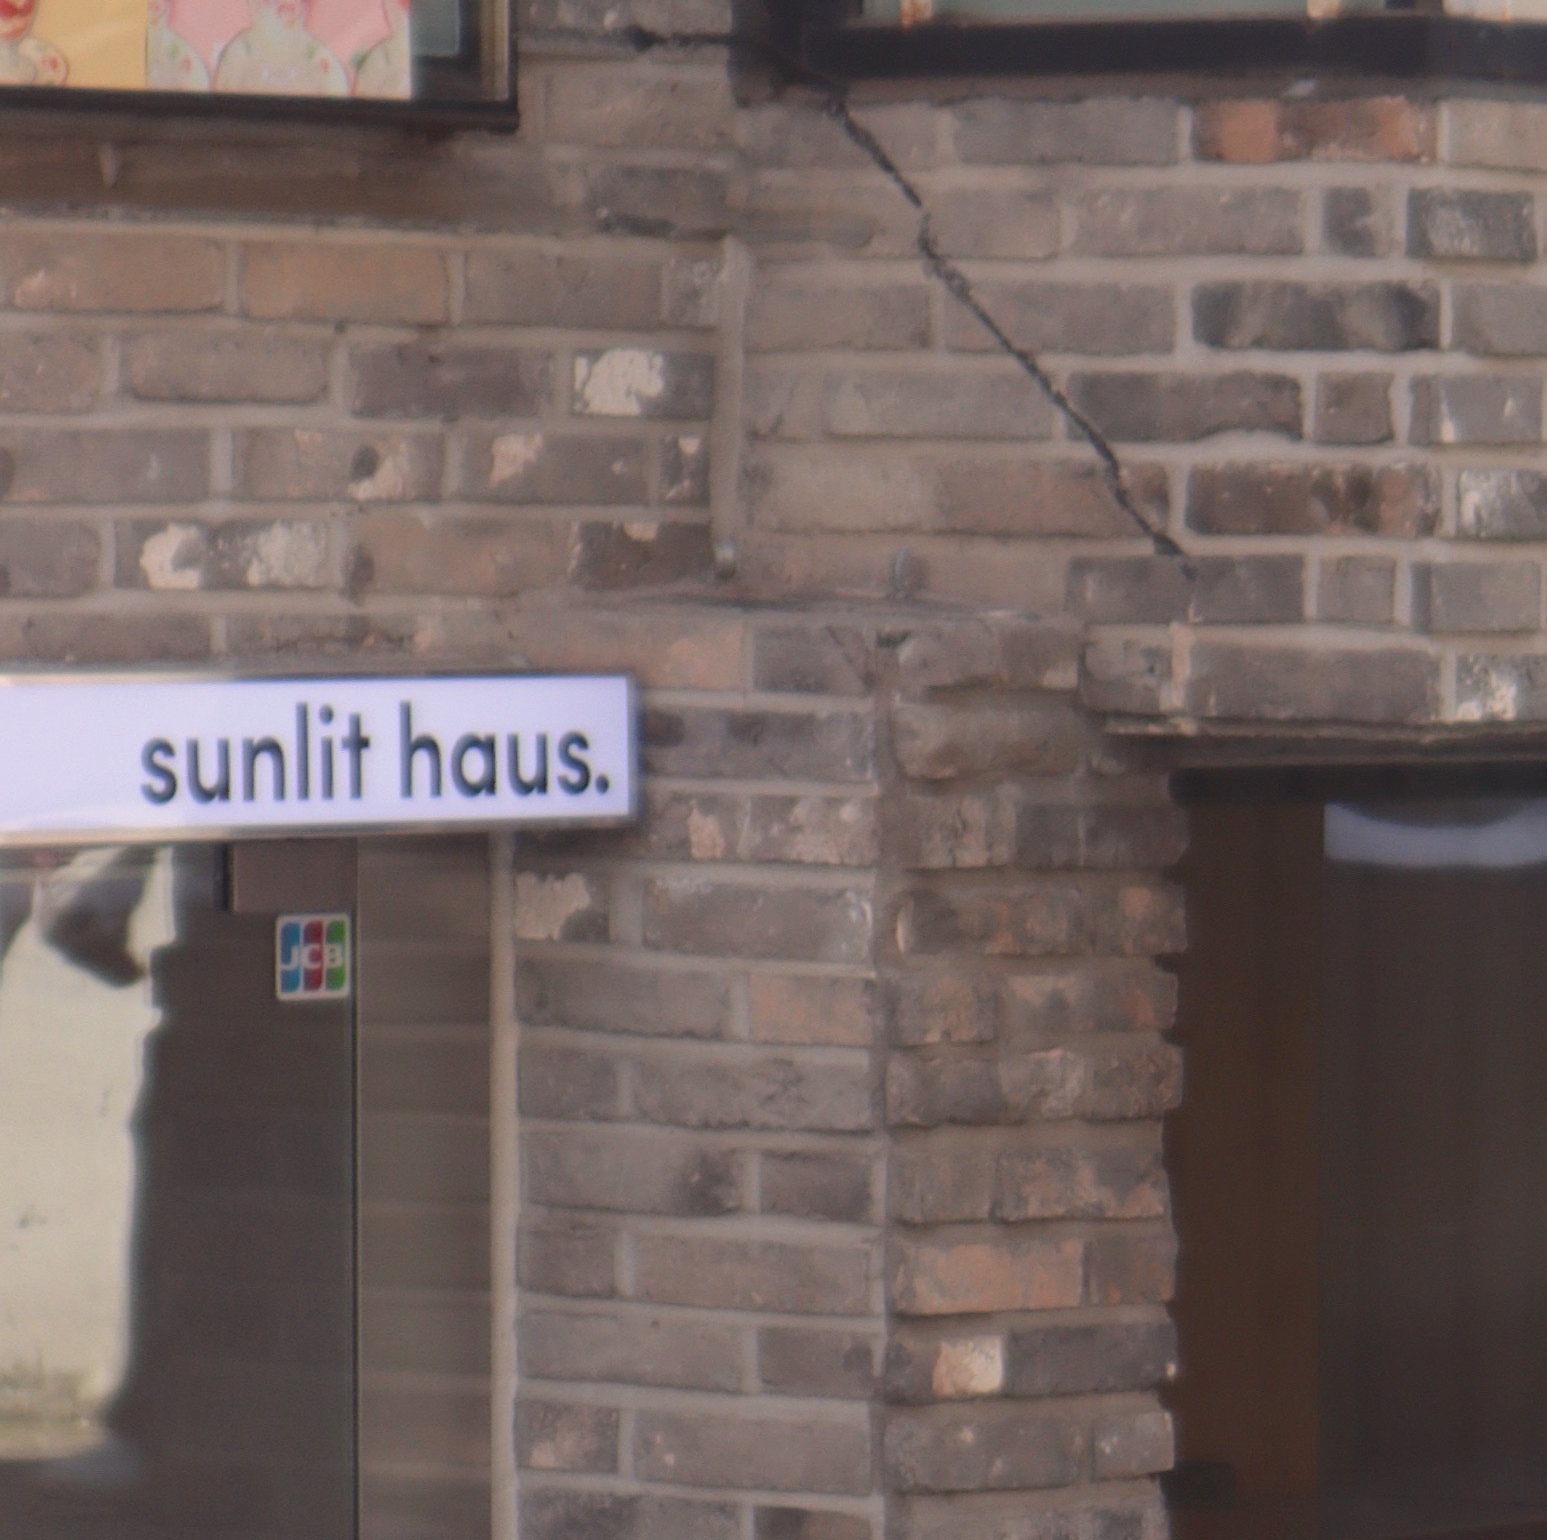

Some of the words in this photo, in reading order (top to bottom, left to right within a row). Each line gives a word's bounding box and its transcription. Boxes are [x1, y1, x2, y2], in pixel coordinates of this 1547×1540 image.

[140, 701, 370, 805] sunlit
[399, 700, 611, 798] haus.
[280, 943, 344, 972] JCB
